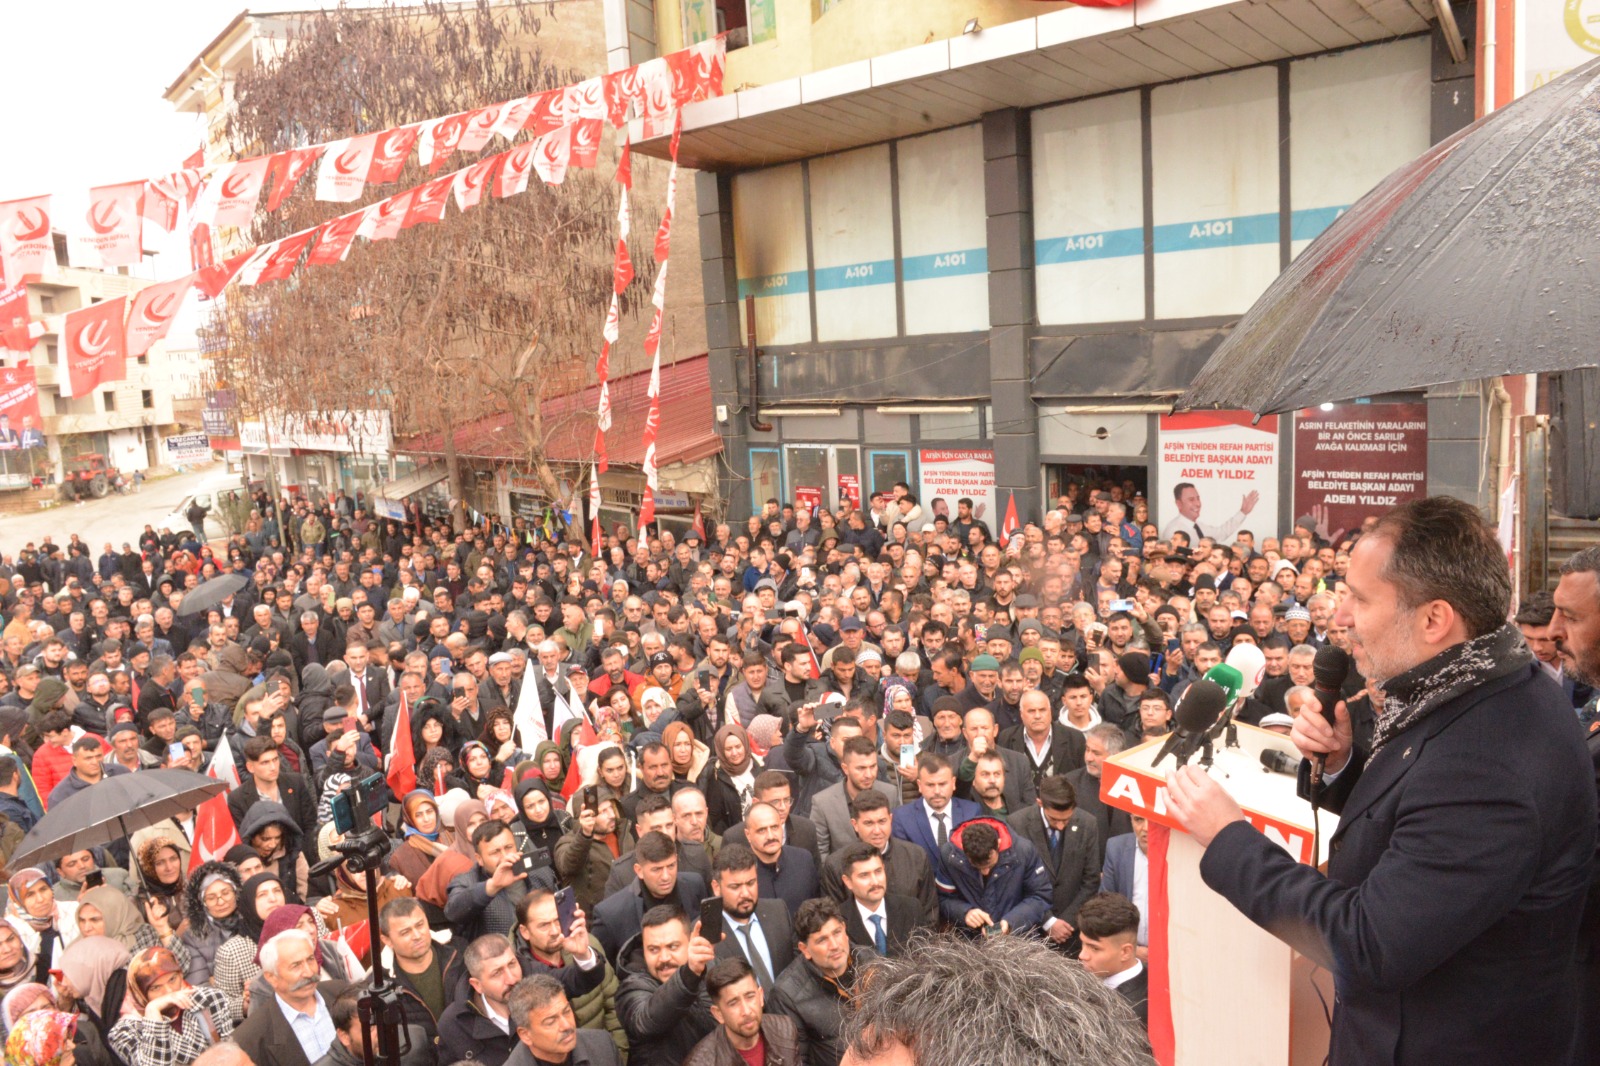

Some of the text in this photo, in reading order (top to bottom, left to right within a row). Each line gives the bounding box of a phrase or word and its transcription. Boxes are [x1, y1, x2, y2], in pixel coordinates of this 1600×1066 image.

[1299, 419, 1426, 431] ASRIN FELAKETİNİN YARALARINI
[1318, 430, 1405, 441] BİR AN ÖNCE SARILIP
[1164, 441, 1274, 452] AFŞİN YENİDEN REFAH PARTİSİ
[1315, 441, 1407, 454] AYAĞA KALKMASI İÇİN
[925, 450, 993, 461] AFŞİN İÇİN CANLA BAŞLA
[1164, 452, 1273, 465] BELEDİYE BAŞKAN ADAYI
[923, 469, 995, 479] AFŞİN YENİDEN REFAH PARTİ
[1181, 468, 1255, 480] ADEM YILDIZ
[1301, 469, 1424, 481] AFŞİN YENİDEN REFAH PARTİSİ
[924, 477, 952, 486] BELEDİYE
[954, 478, 979, 487] BAŞKAN
[1307, 480, 1414, 493] BELEDİYE BAŞKAN ADAYI
[935, 488, 988, 497] ADEM YILDIZ
[1323, 494, 1398, 506] ADEM YILDIZ
